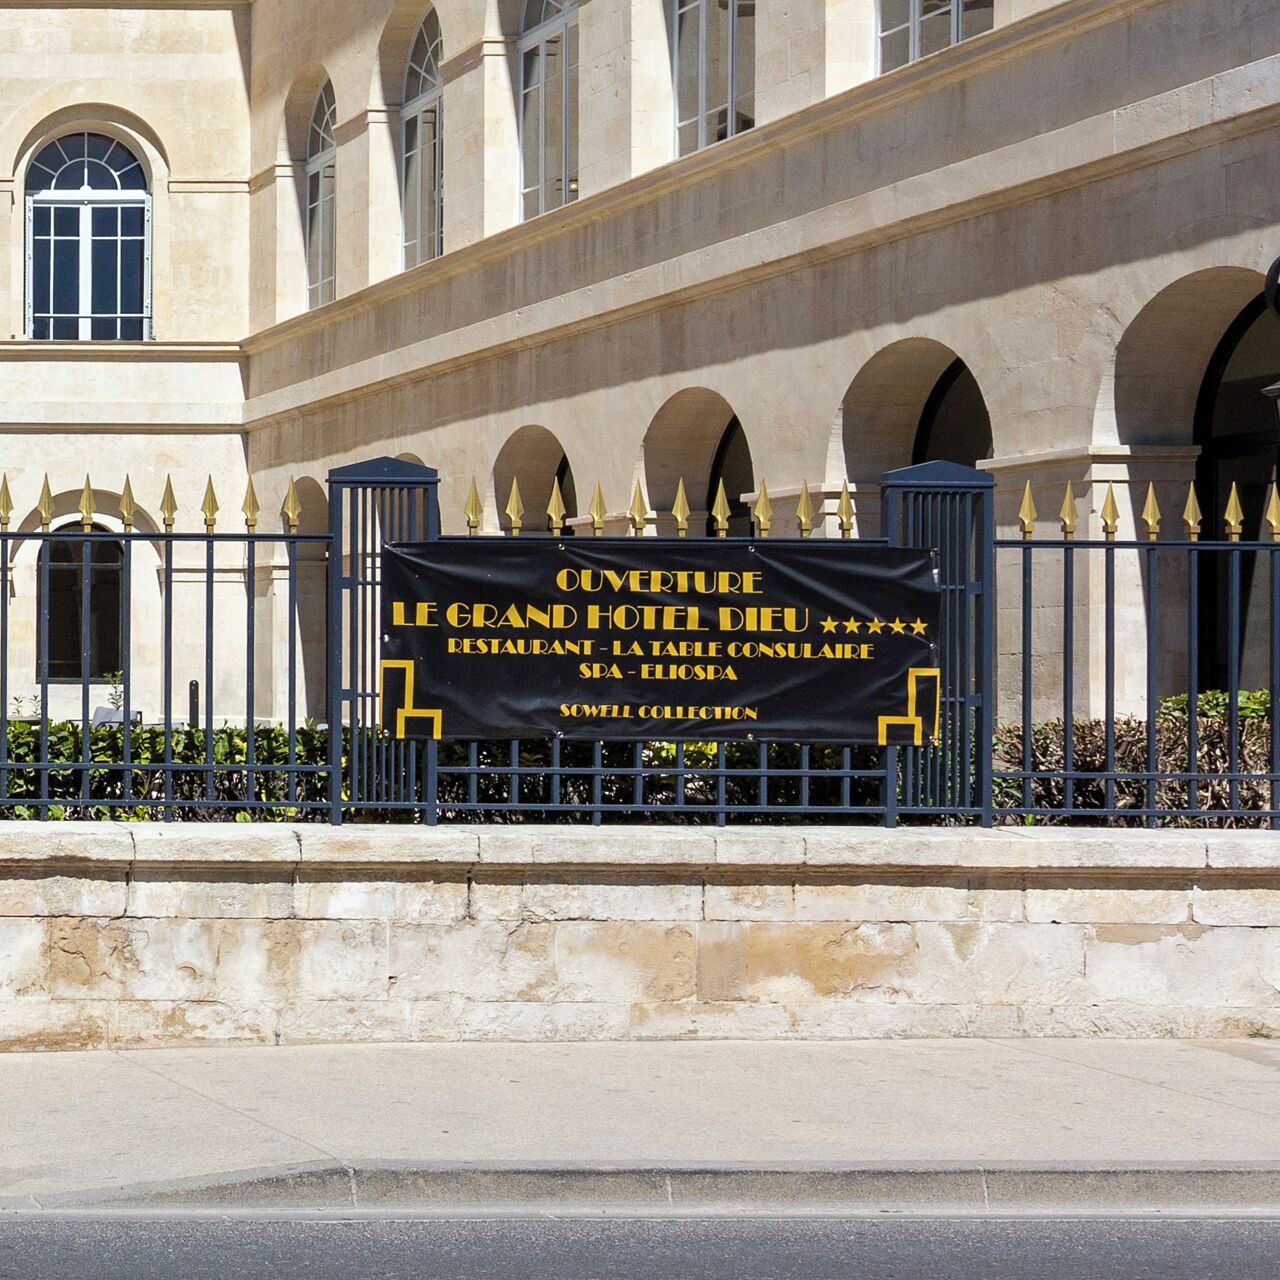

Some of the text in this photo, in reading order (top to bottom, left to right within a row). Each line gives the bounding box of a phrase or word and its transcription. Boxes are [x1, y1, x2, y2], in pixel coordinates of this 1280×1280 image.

[555, 568, 764, 594] OUVERTURE
[392, 601, 809, 633] LE GRAND HOTEL DIEU
[447, 637, 596, 656] RESTAURANT
[612, 640, 644, 656] LA
[648, 640, 723, 658] TABLE
[727, 641, 875, 660] CONSULAIRE
[578, 662, 624, 680] SPA
[640, 663, 738, 681] ELIOSPA
[559, 703, 758, 721] SOWELL COLLECTION
